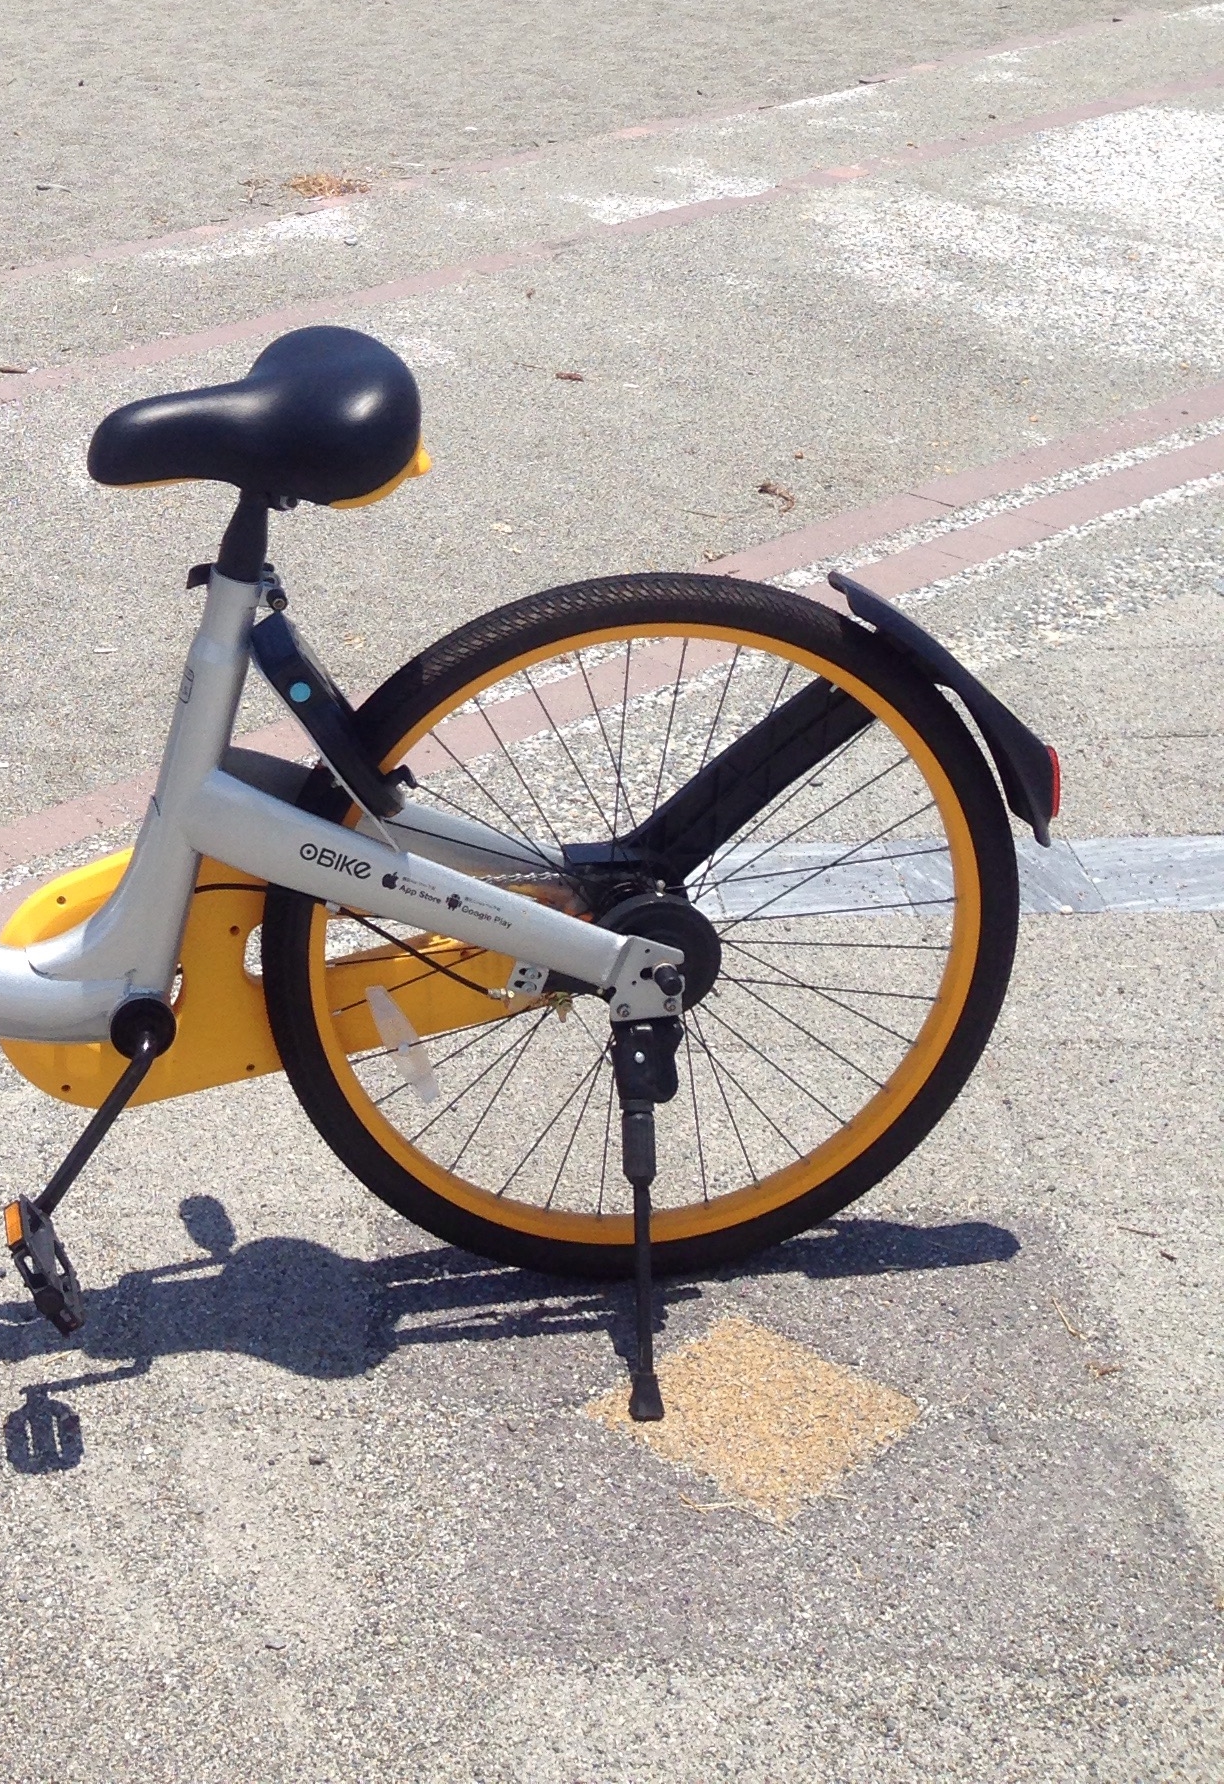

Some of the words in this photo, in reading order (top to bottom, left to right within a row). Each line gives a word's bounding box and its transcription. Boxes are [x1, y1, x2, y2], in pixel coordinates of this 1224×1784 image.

[399, 885, 417, 896] App
[419, 890, 442, 904] Store
[461, 905, 492, 921] Google
[494, 915, 513, 929] Play
